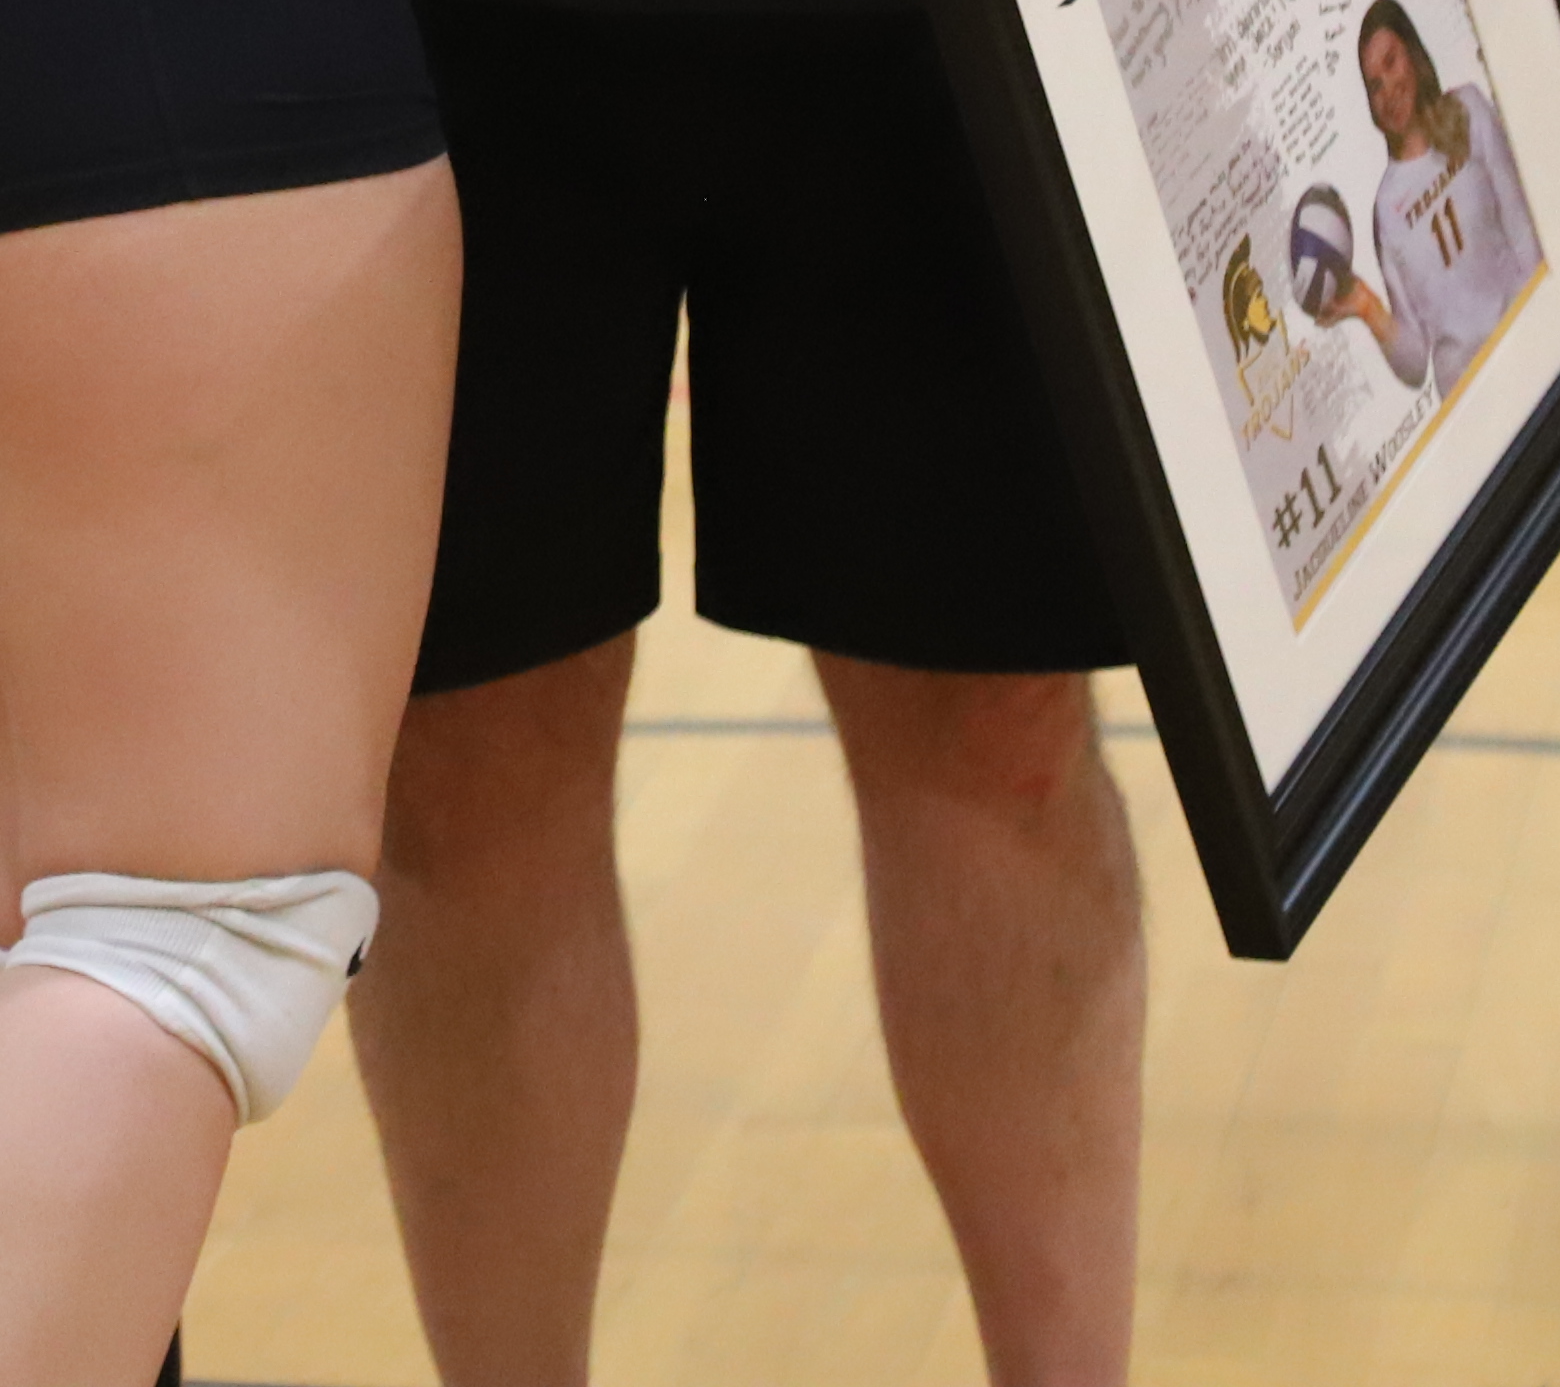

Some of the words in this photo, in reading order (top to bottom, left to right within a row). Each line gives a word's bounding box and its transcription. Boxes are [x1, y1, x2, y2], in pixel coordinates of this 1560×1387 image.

[1431, 197, 1464, 268] 11
[1240, 336, 1312, 450] TROJANS
[1271, 443, 1343, 550] #11
